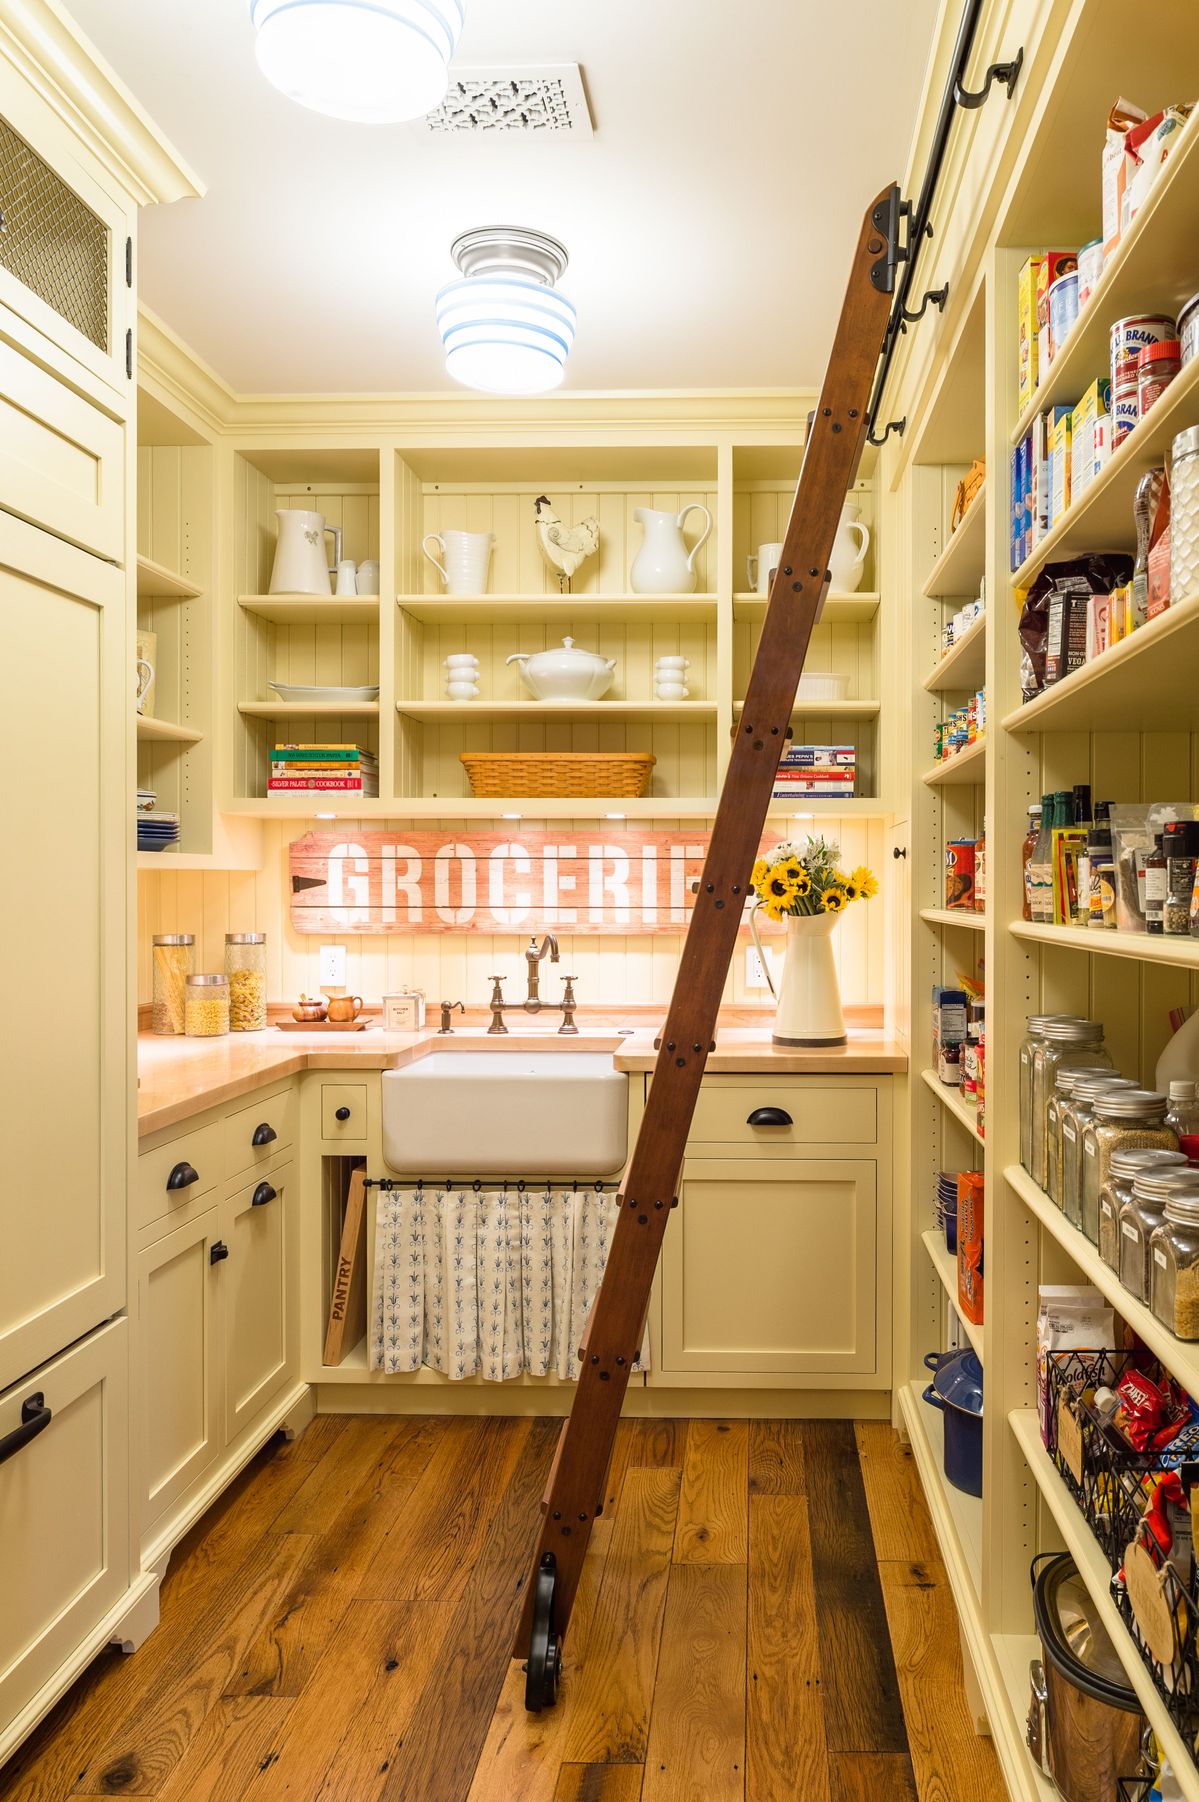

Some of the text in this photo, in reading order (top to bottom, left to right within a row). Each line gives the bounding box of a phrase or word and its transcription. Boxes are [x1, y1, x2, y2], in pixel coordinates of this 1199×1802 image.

[1116, 404, 1138, 417] BRAN
[1068, 657, 1087, 665] VEGA
[327, 843, 704, 925] GROCERIE
[331, 1255, 353, 1321] PANTRY
